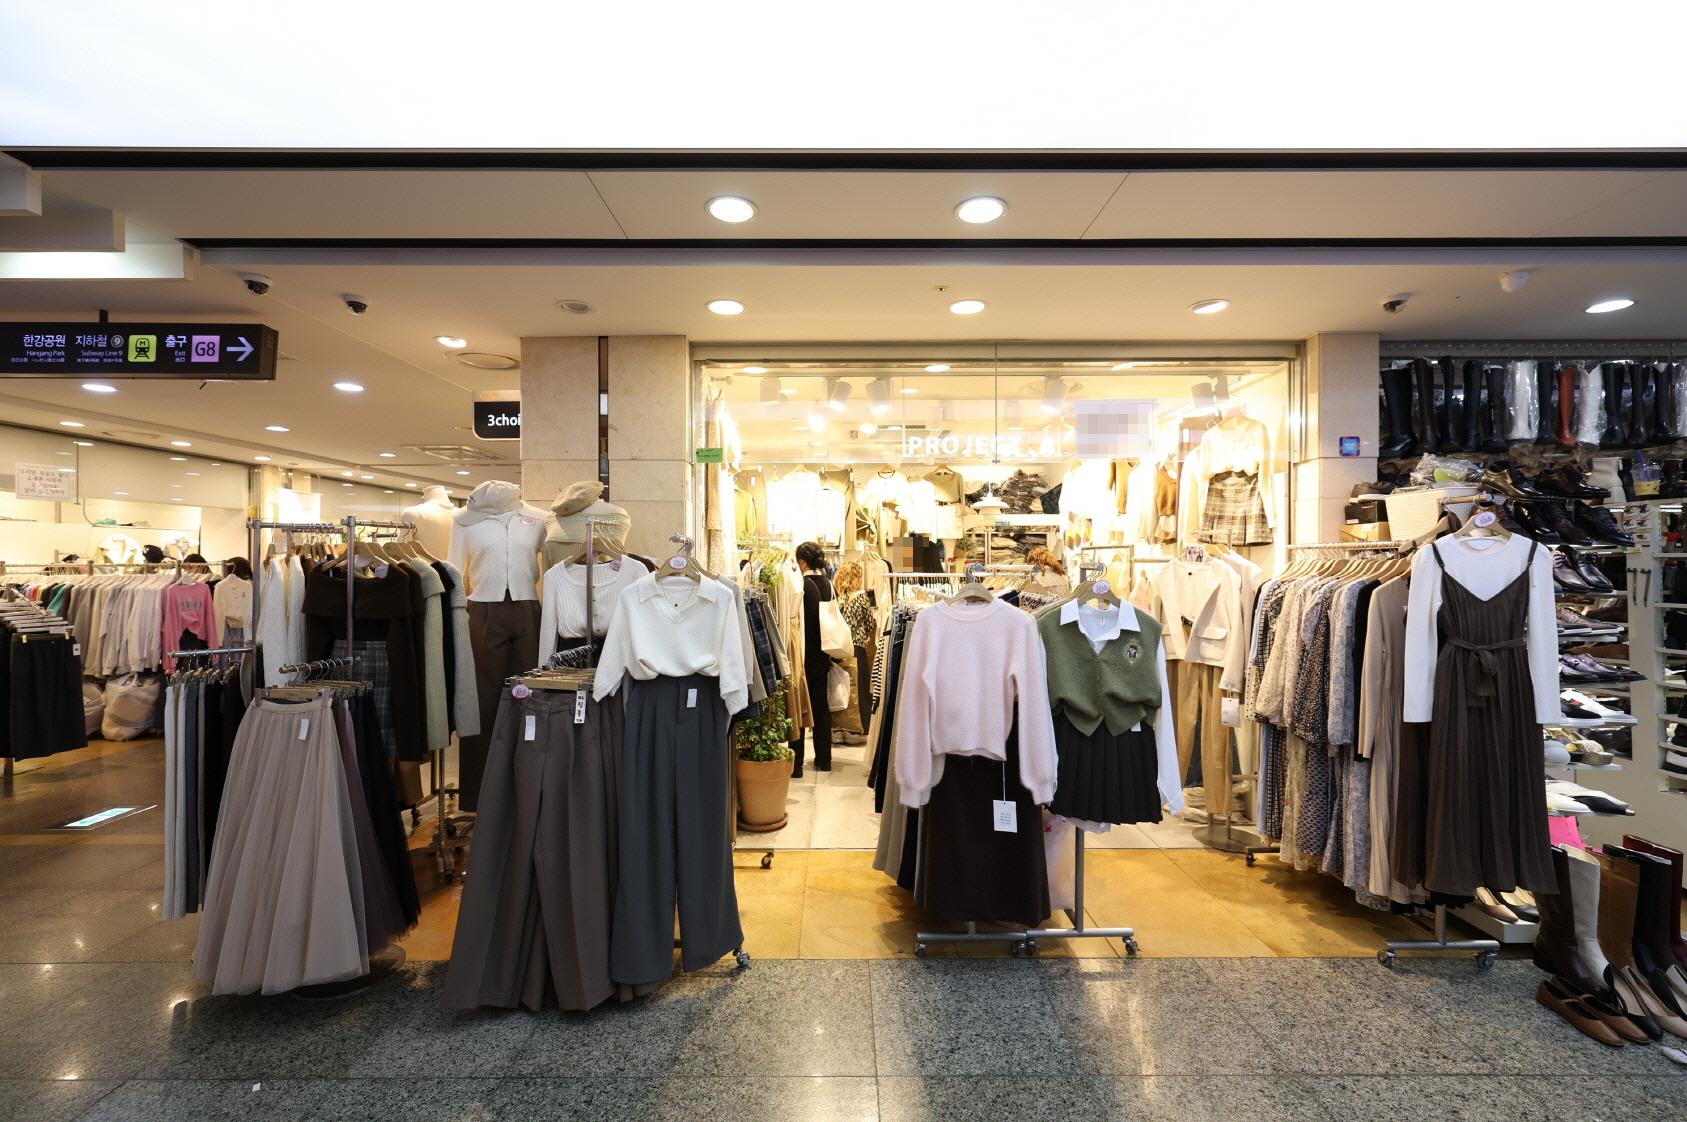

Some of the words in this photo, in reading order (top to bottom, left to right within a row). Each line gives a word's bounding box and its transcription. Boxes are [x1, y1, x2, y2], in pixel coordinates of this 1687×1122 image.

[23, 334, 66, 347] 한강공원
[75, 334, 107, 347] 지하철
[165, 334, 188, 348] 출구
[195, 341, 216, 357] G8
